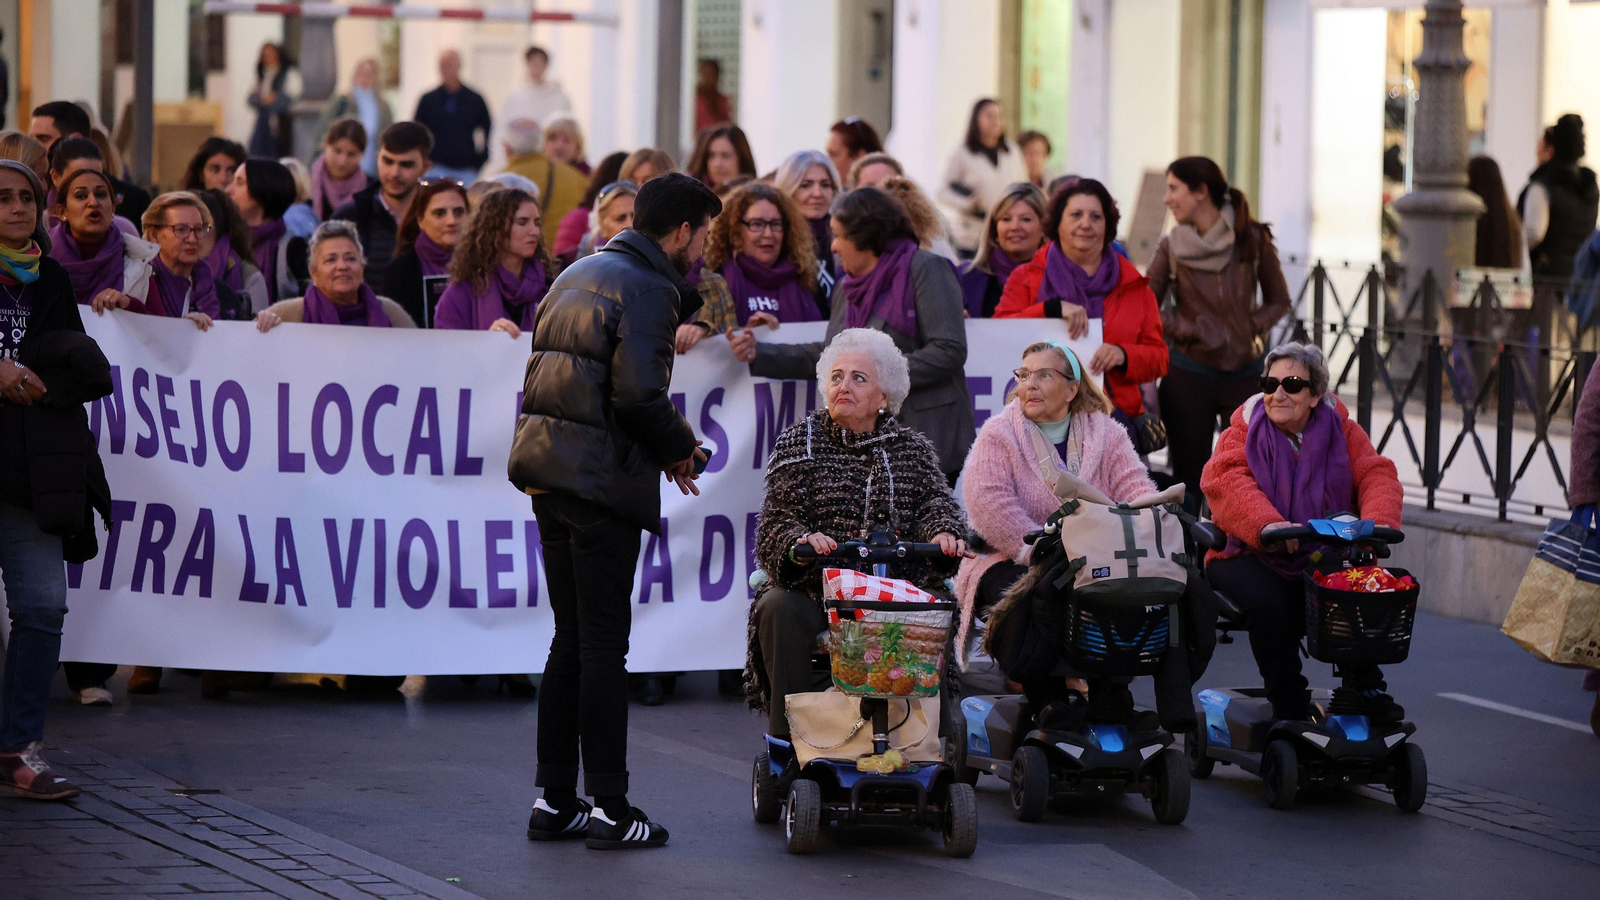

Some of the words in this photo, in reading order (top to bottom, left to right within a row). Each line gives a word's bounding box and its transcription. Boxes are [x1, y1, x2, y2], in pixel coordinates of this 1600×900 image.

[91, 365, 251, 472] NSEJO
[278, 382, 484, 476] LOCAL
[67, 499, 215, 598] TRA
[238, 514, 307, 608] LA
